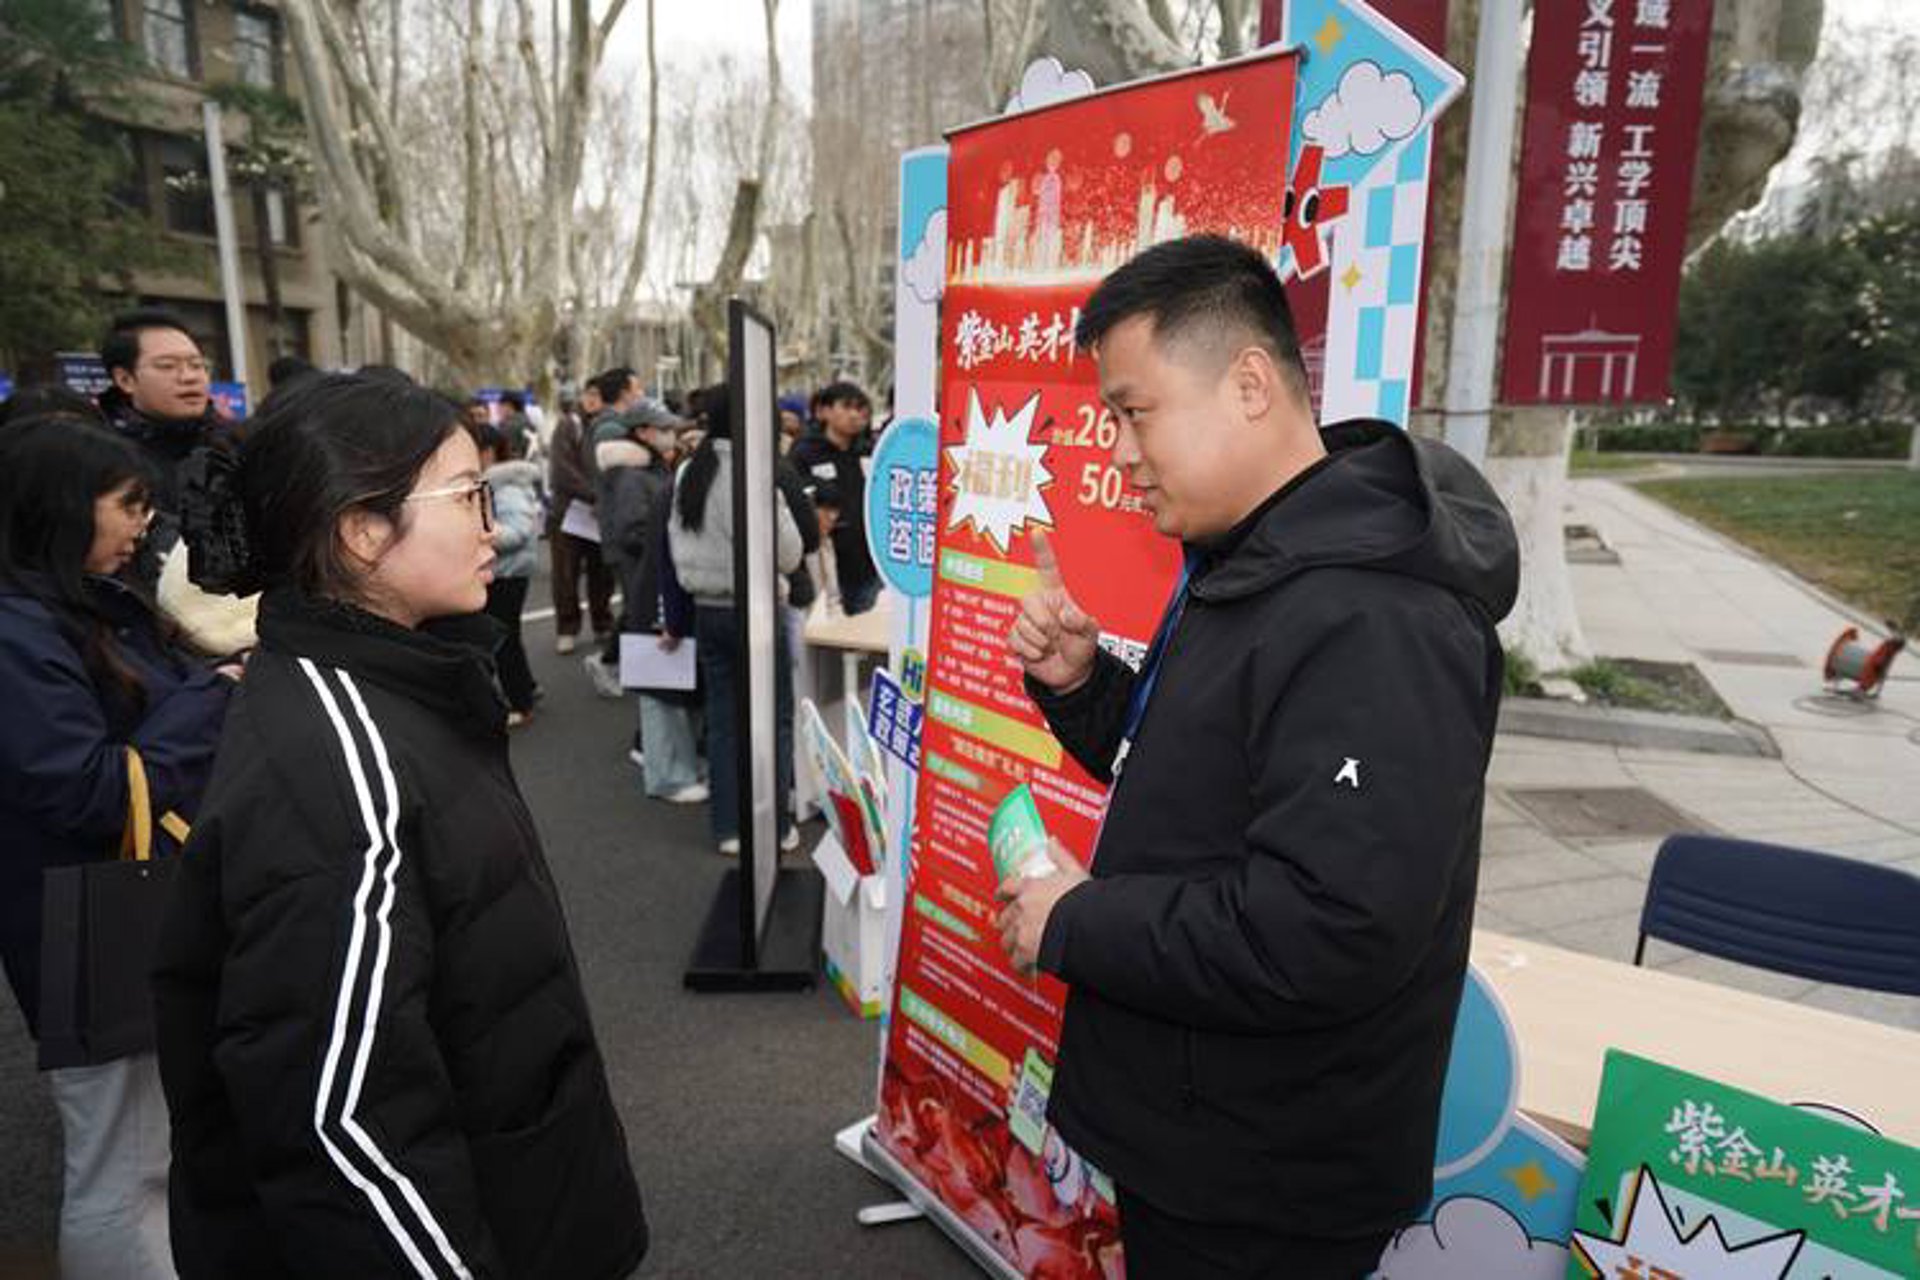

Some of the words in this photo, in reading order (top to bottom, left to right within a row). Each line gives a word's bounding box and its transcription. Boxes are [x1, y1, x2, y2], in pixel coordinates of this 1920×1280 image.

[1556, 122, 1604, 271] 新兴卓越
[1608, 124, 1655, 271] 工学顶尖
[1663, 1099, 1920, 1232] 紫金山英才
